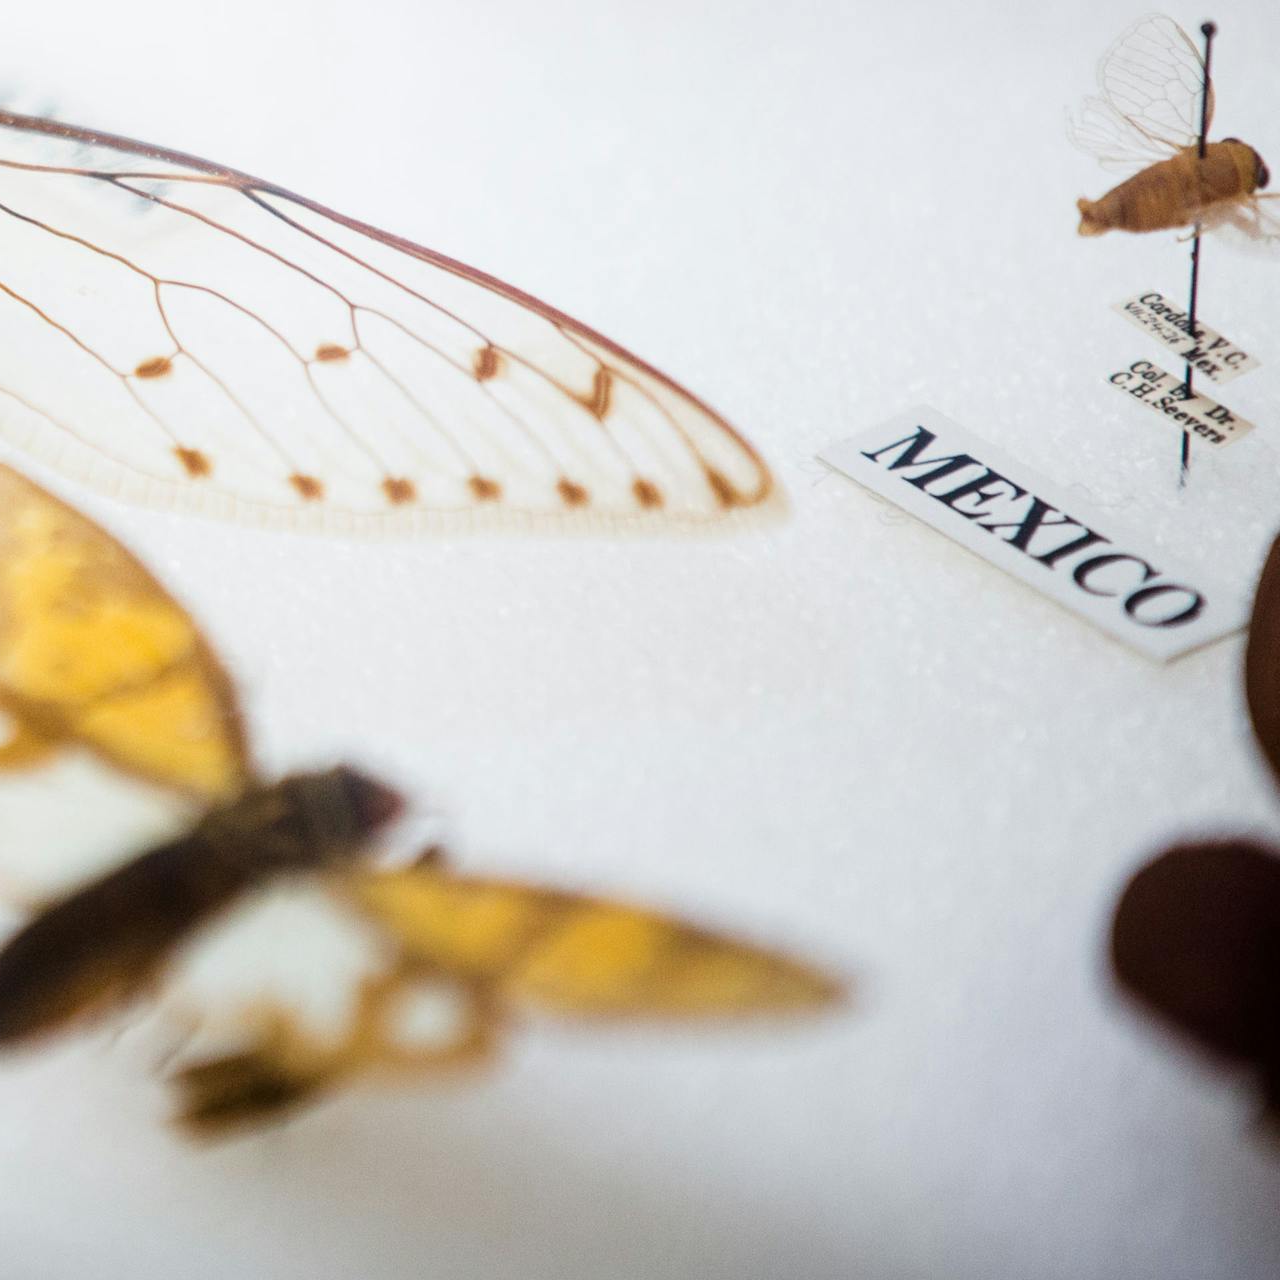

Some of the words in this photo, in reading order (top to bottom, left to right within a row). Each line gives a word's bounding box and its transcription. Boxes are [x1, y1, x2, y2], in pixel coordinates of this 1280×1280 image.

[1130, 361, 1167, 388] Col.
[1204, 404, 1235, 431] Dr.
[860, 425, 1206, 628] MEXICO
